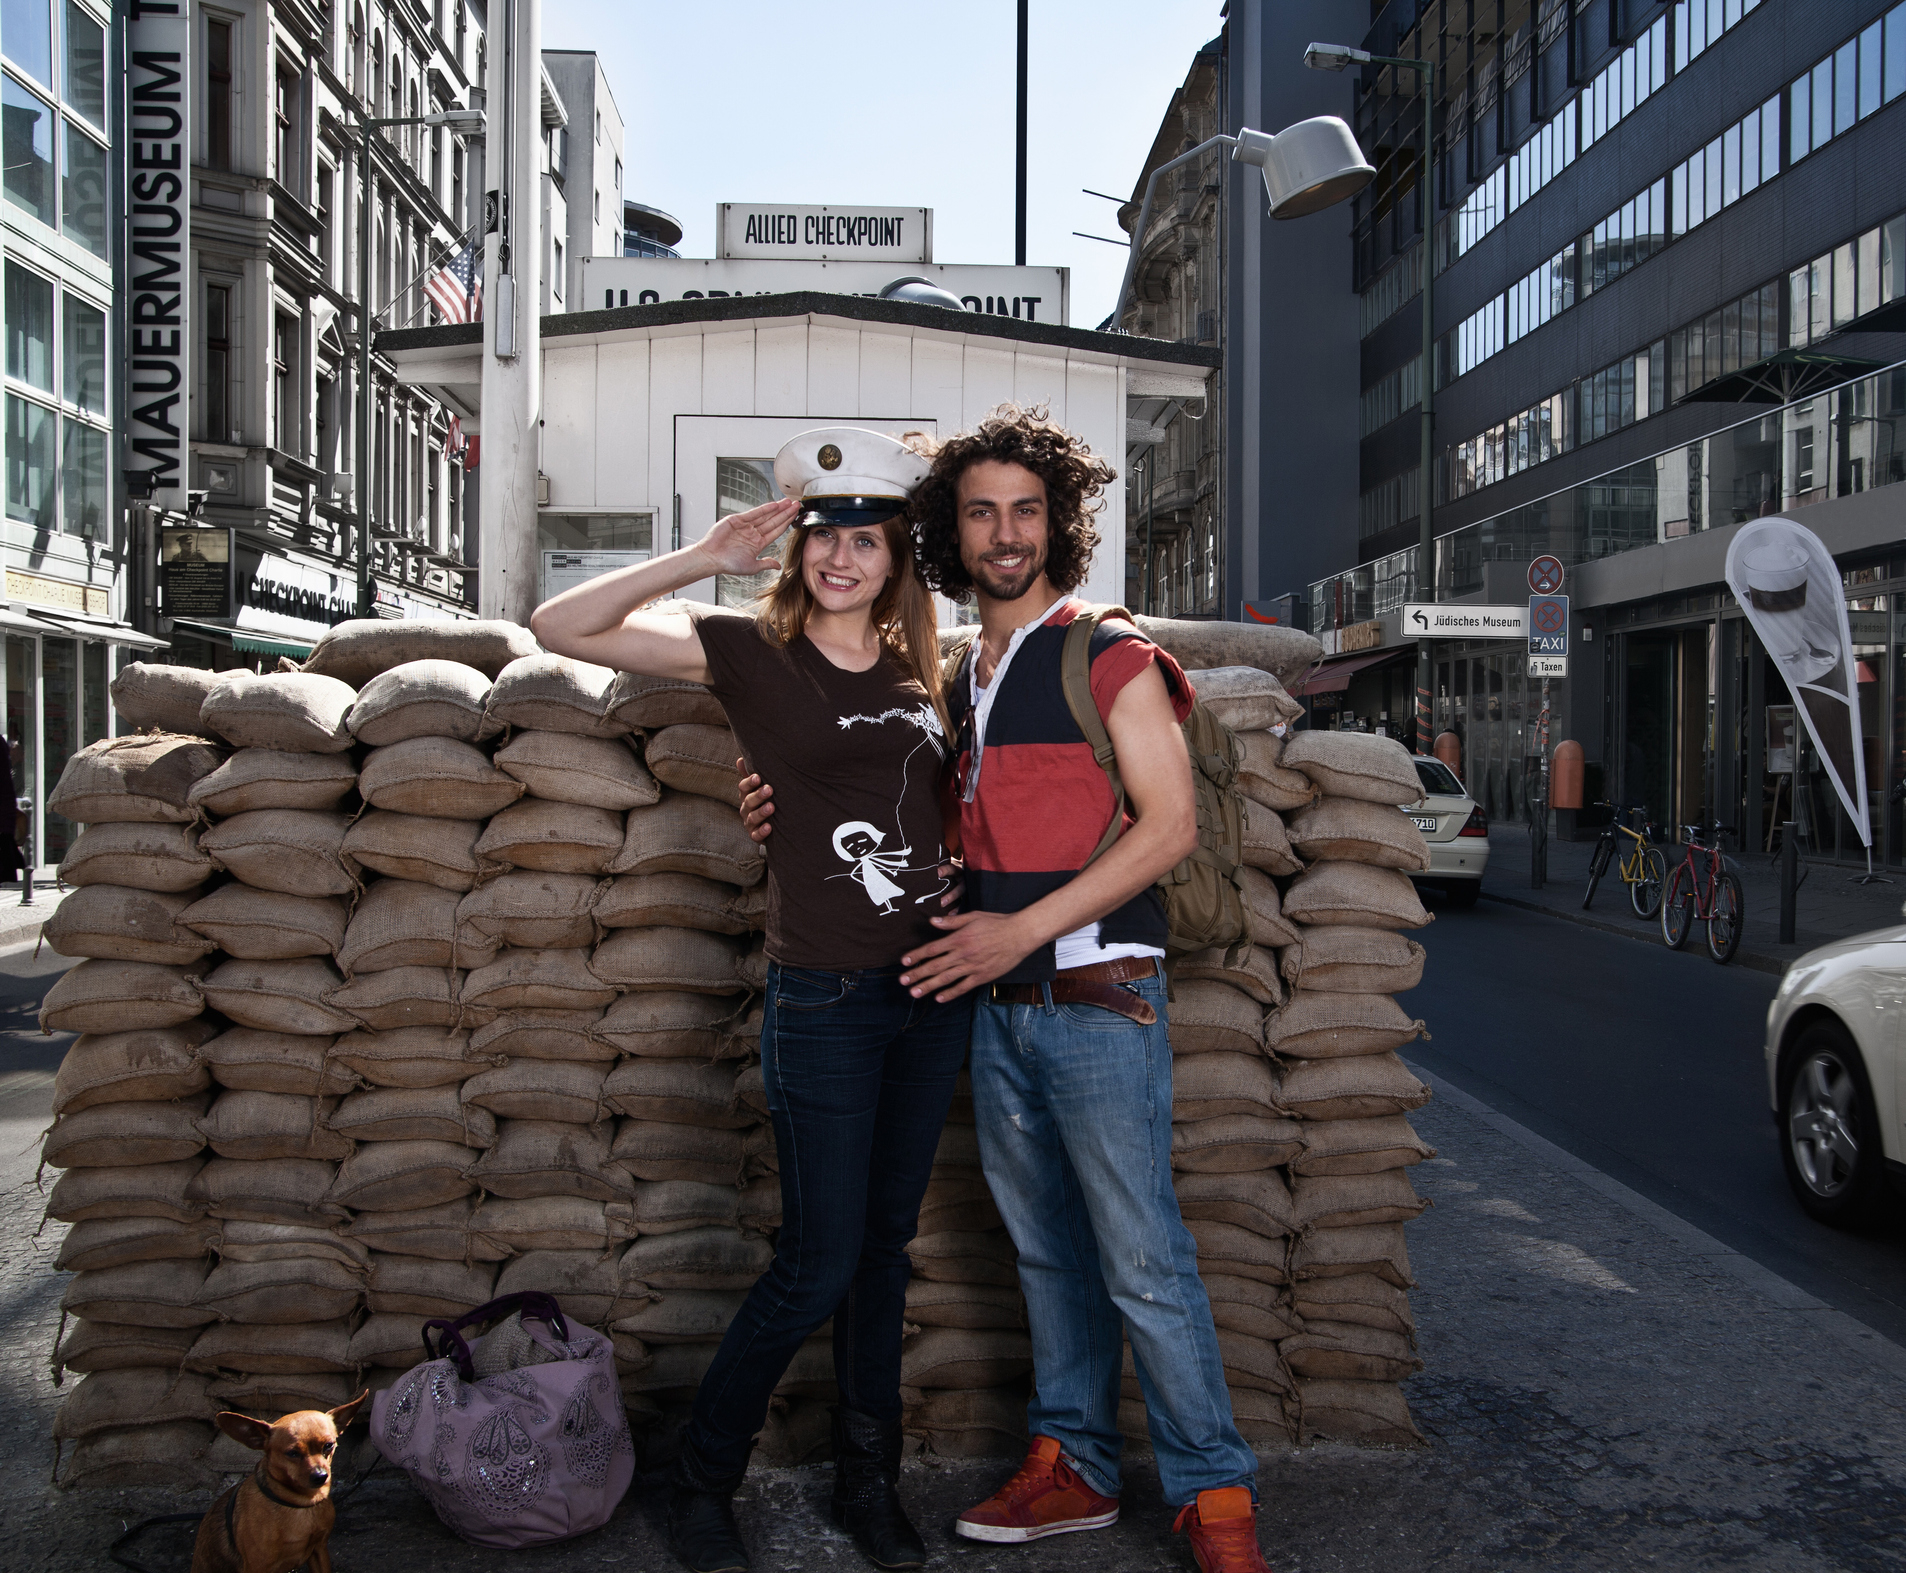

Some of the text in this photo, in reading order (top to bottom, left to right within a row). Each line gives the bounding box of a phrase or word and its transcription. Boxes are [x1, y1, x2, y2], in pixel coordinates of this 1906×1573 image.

[745, 214, 904, 247] ALLIED CHECKPOINT
[132, 51, 183, 488] MAUERMUSEUM
[249, 574, 327, 624] CHECKPOINT
[1434, 615, 1521, 628] Jüdisches Museum
[1532, 636, 1564, 650] TAXI
[1540, 661, 1563, 672] Taxen
